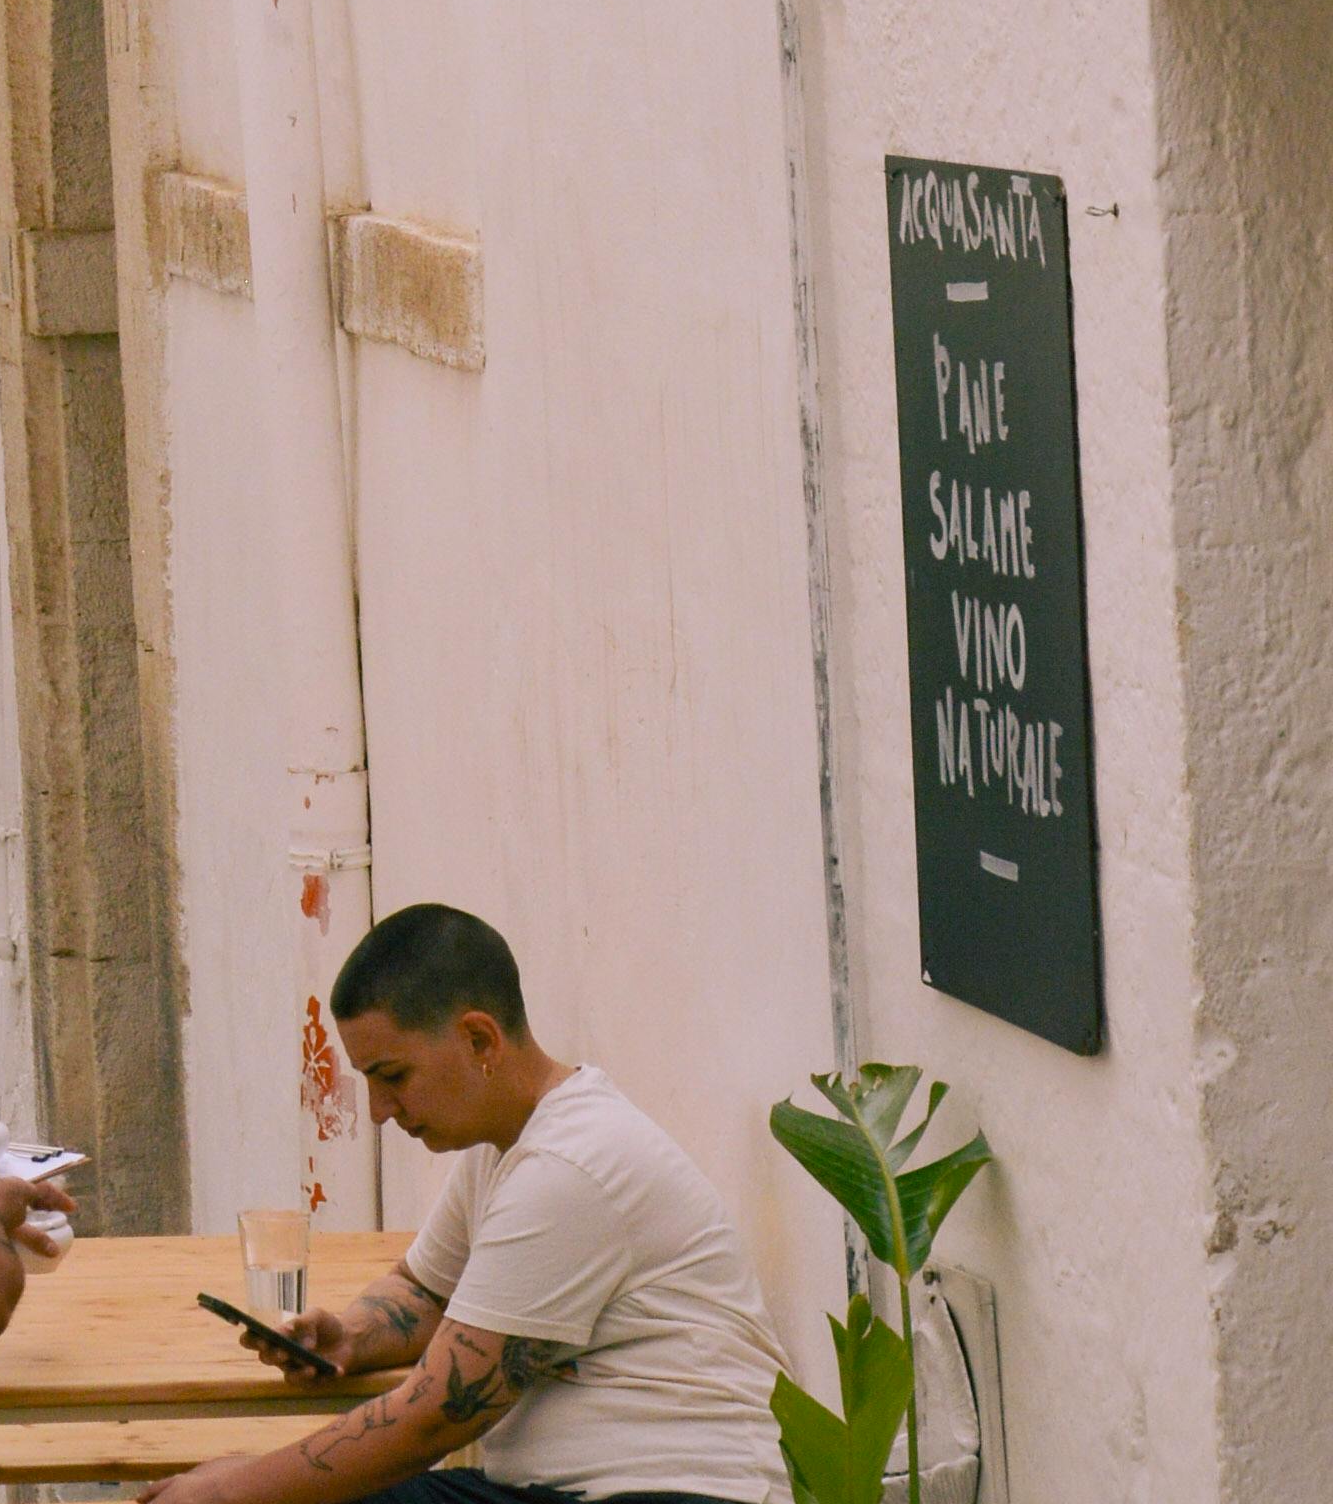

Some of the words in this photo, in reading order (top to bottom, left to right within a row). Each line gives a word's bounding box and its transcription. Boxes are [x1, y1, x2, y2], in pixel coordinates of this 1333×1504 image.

[898, 169, 1046, 270] ACQUASANTA
[933, 330, 1010, 455] PANE
[928, 469, 1036, 580] SALAME
[950, 589, 1027, 692] VINO
[935, 685, 1064, 818] NATURALE
